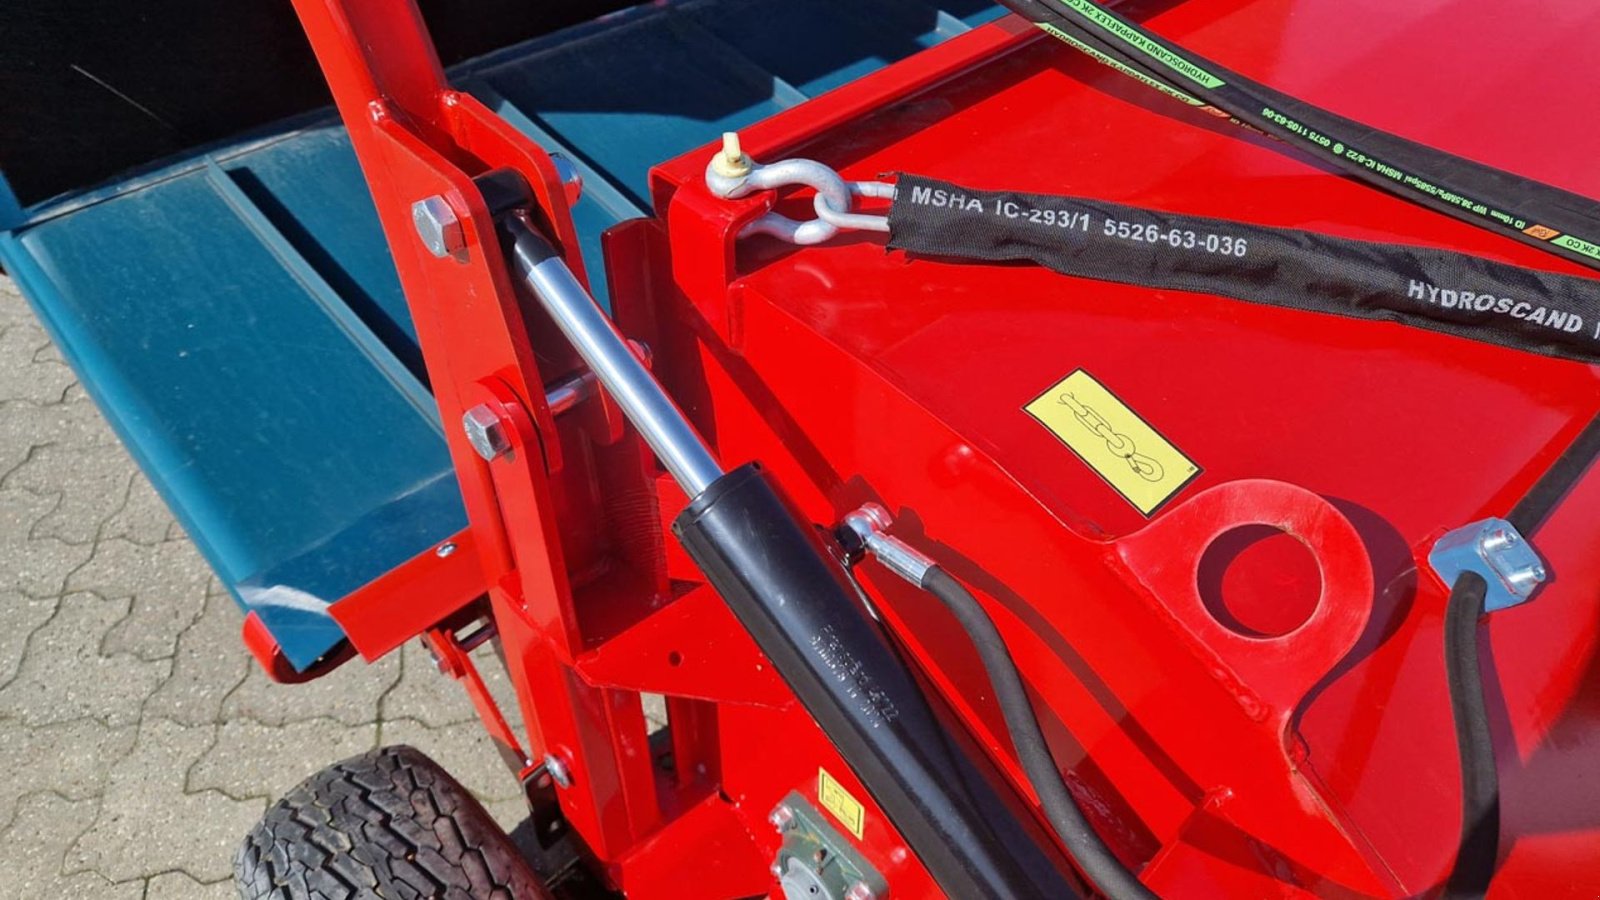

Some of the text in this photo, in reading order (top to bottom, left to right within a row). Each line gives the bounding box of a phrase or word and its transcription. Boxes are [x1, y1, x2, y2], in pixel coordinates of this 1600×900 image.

[1081, 3, 1095, 16] 2K
[1094, 11, 1146, 47] KAPPAFLEX
[1146, 43, 1210, 84] HYDROSCAND
[1262, 107, 1308, 136] 1105-63-06
[1308, 131, 1331, 147] 0575
[1376, 164, 1403, 181] MSHA
[1473, 203, 1487, 216] WP
[1490, 209, 1514, 225] 10mm
[911, 185, 1248, 257] MSHA IC-293/1 5526-63-036
[1514, 219, 1526, 230] ID
[1566, 238, 1581, 249] CO
[1407, 279, 1583, 333] HYDROSCAND
